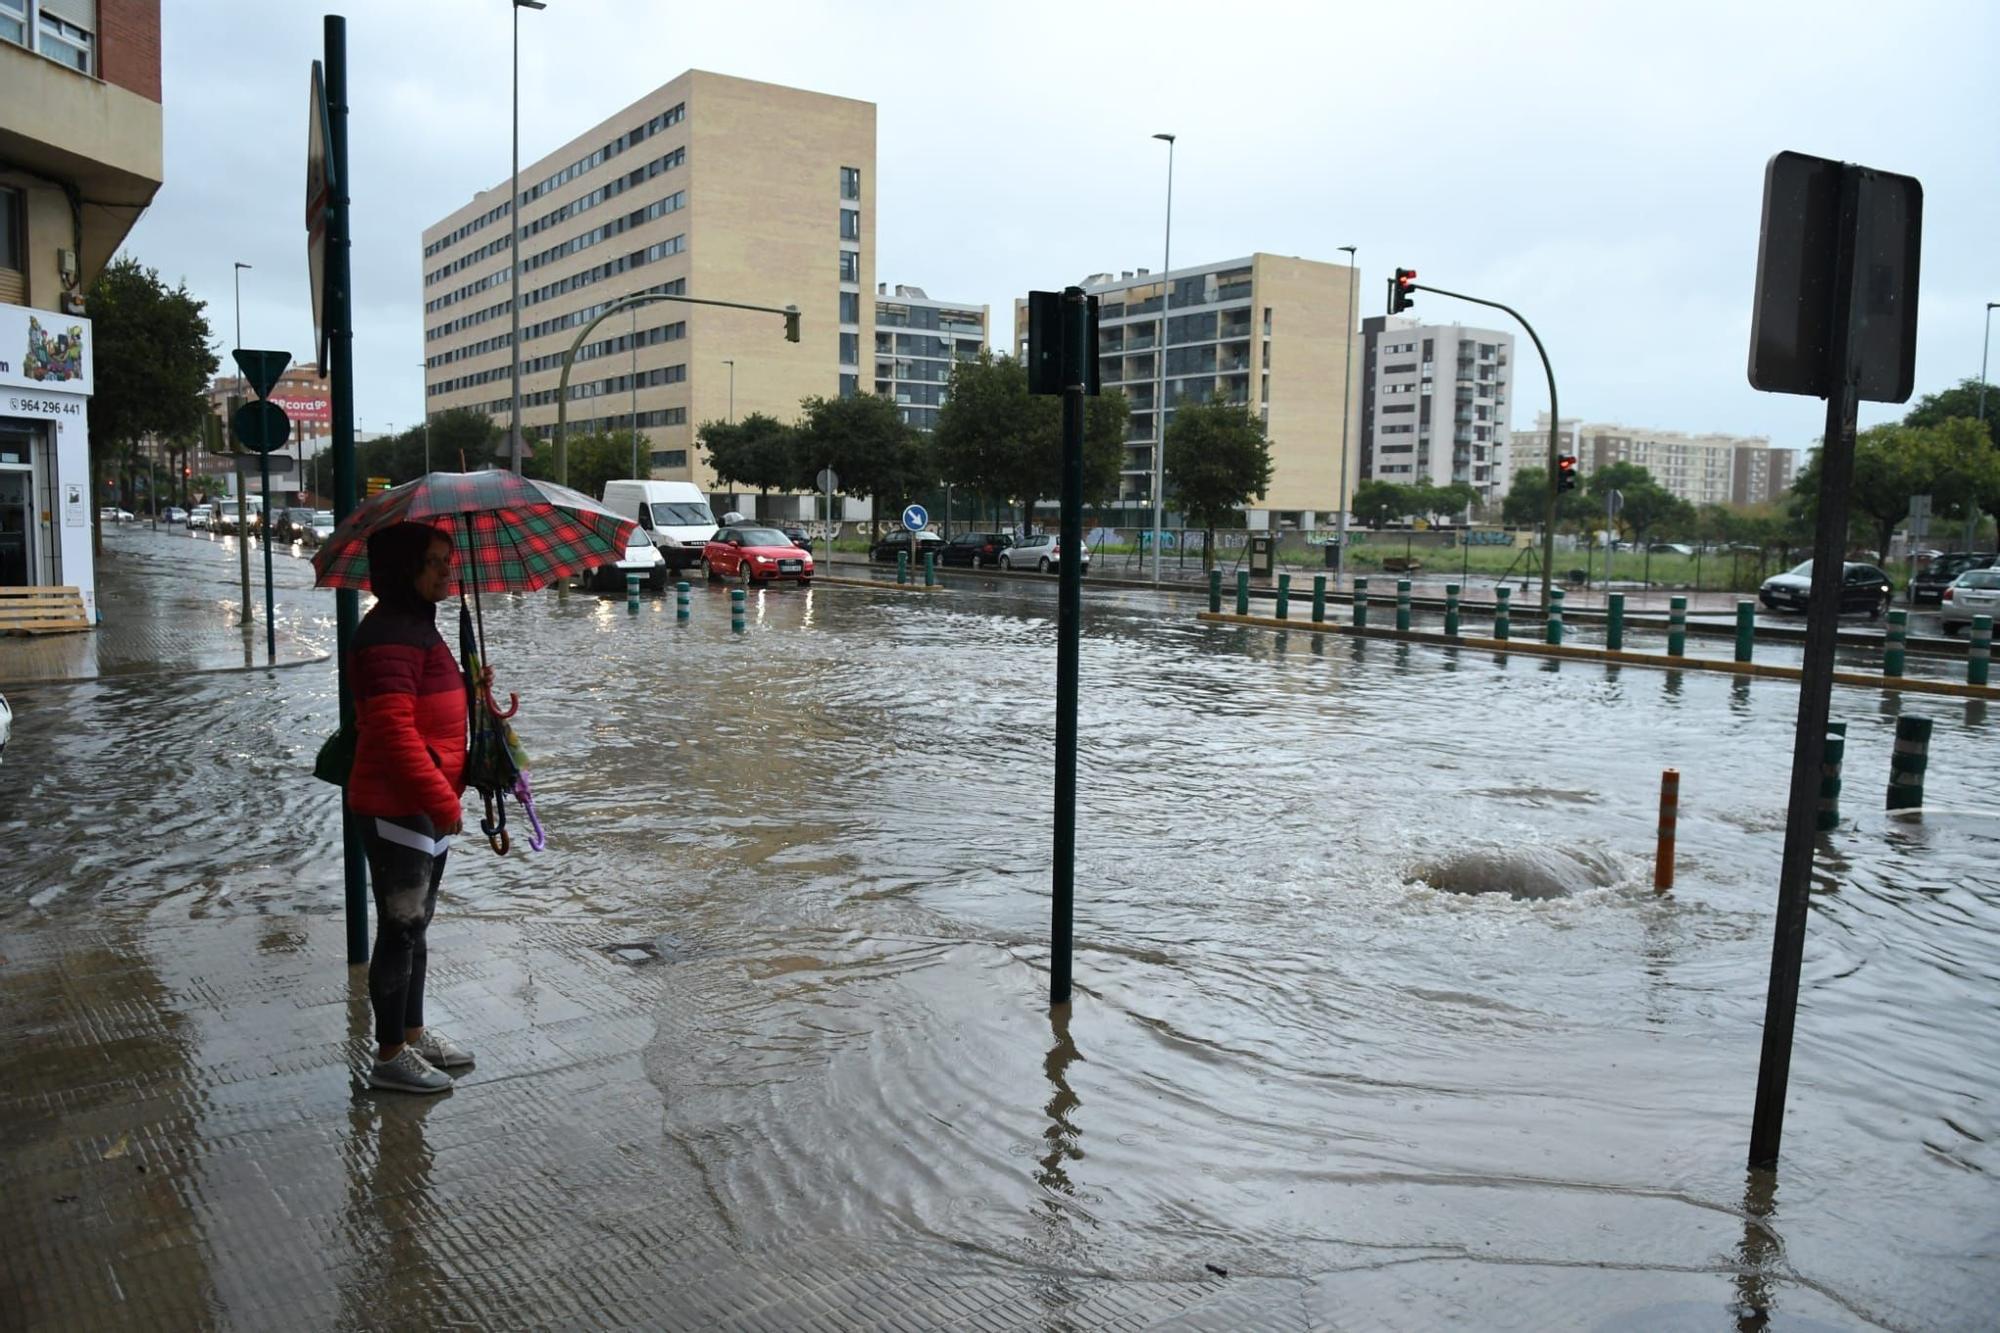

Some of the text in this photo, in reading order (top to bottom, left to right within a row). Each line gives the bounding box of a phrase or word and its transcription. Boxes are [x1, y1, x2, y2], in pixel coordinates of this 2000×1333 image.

[20, 399, 80, 415] 964 296 441
